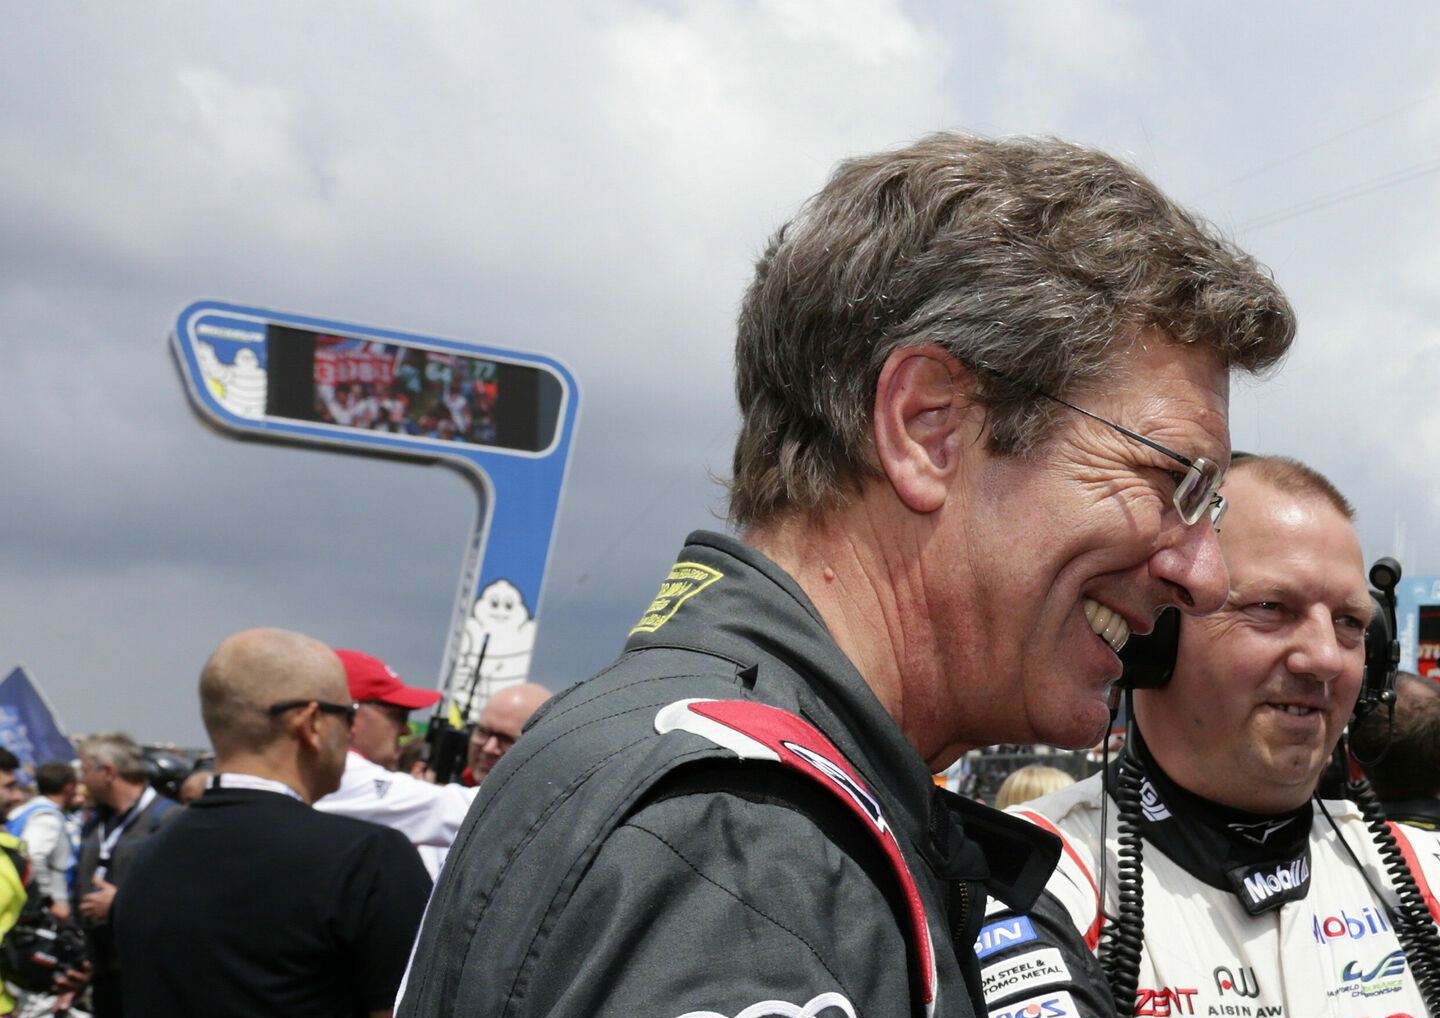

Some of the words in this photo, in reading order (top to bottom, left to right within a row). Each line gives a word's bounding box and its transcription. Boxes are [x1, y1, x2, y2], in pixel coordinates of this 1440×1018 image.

[1242, 859, 1303, 904] Mobil
[974, 922, 1022, 954] SIN
[1313, 906, 1389, 945] Mobil
[983, 977, 1019, 996] TOMO
[1022, 965, 1064, 982] METAL
[999, 960, 1034, 979] STEEL
[1036, 958, 1046, 968] &
[1133, 986, 1199, 1018] ZENT
[1208, 1004, 1251, 1017] AISIN
[1255, 1005, 1283, 1018] AW
